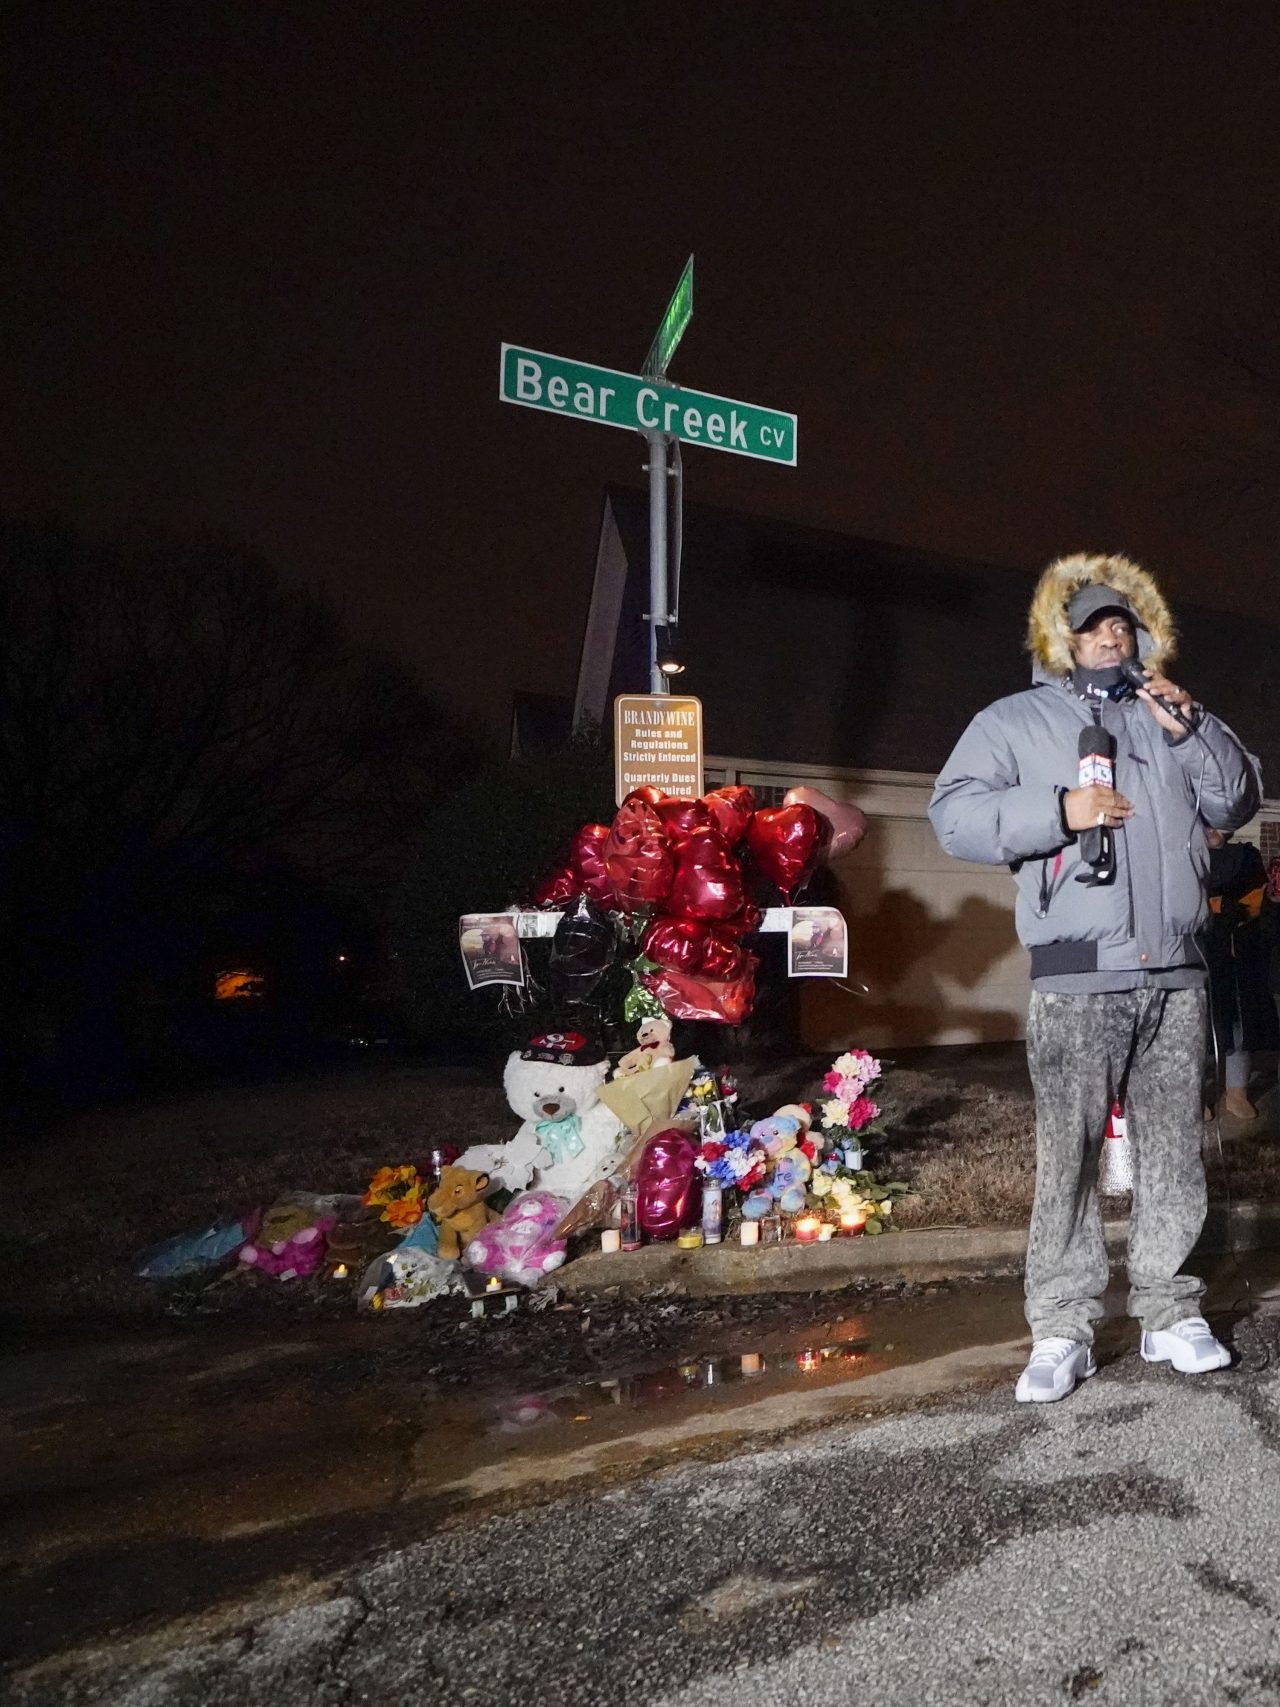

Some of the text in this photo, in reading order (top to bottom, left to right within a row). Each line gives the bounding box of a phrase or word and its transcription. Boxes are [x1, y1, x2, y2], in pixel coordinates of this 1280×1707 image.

[516, 357, 785, 449] Bear Creek CV
[624, 710, 695, 726] BRANDYWINE
[635, 729, 683, 739] Rules and
[631, 740, 689, 750] Regulations
[623, 752, 696, 763] Strictly Enforced
[624, 773, 696, 783] Quarterly Dues
